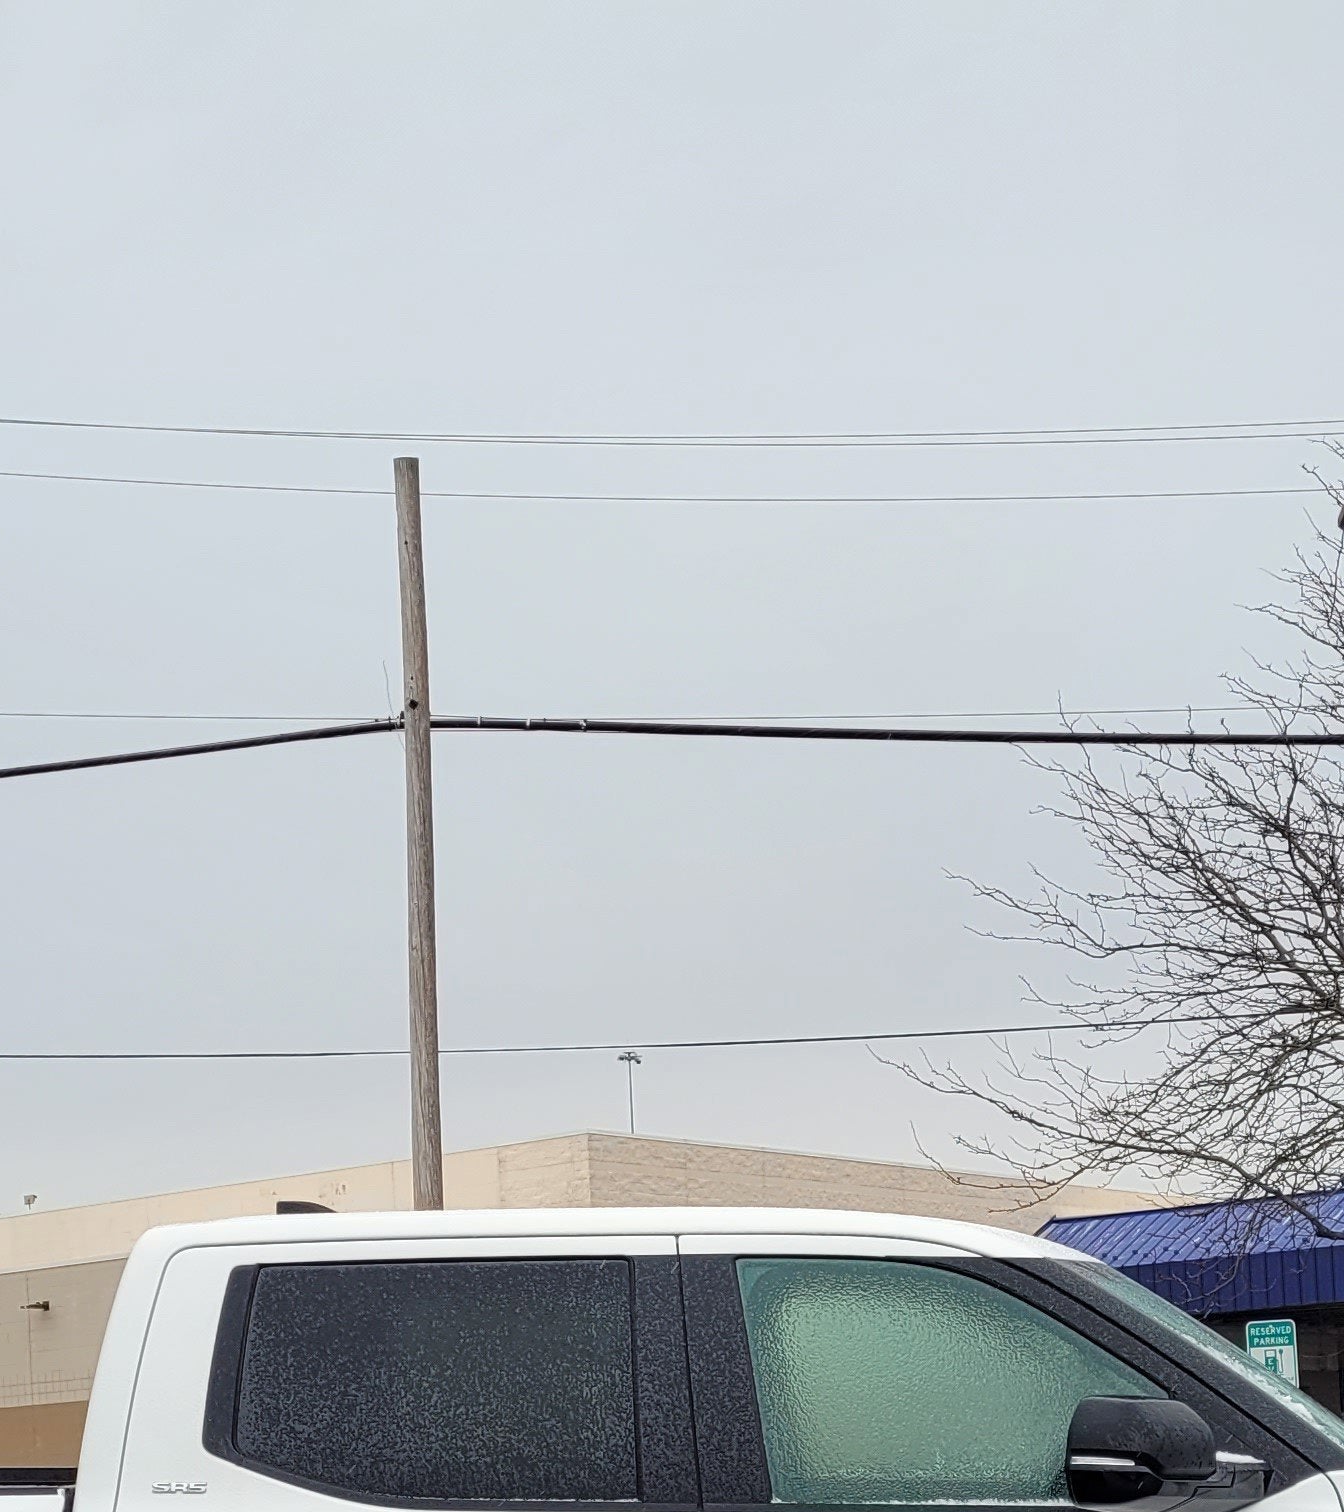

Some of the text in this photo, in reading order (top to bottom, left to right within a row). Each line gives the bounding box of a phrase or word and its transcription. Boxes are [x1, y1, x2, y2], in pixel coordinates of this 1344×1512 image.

[1250, 1326, 1292, 1336] RESERVED
[1253, 1336, 1290, 1346] PARKING
[151, 1481, 207, 1494] SR5
